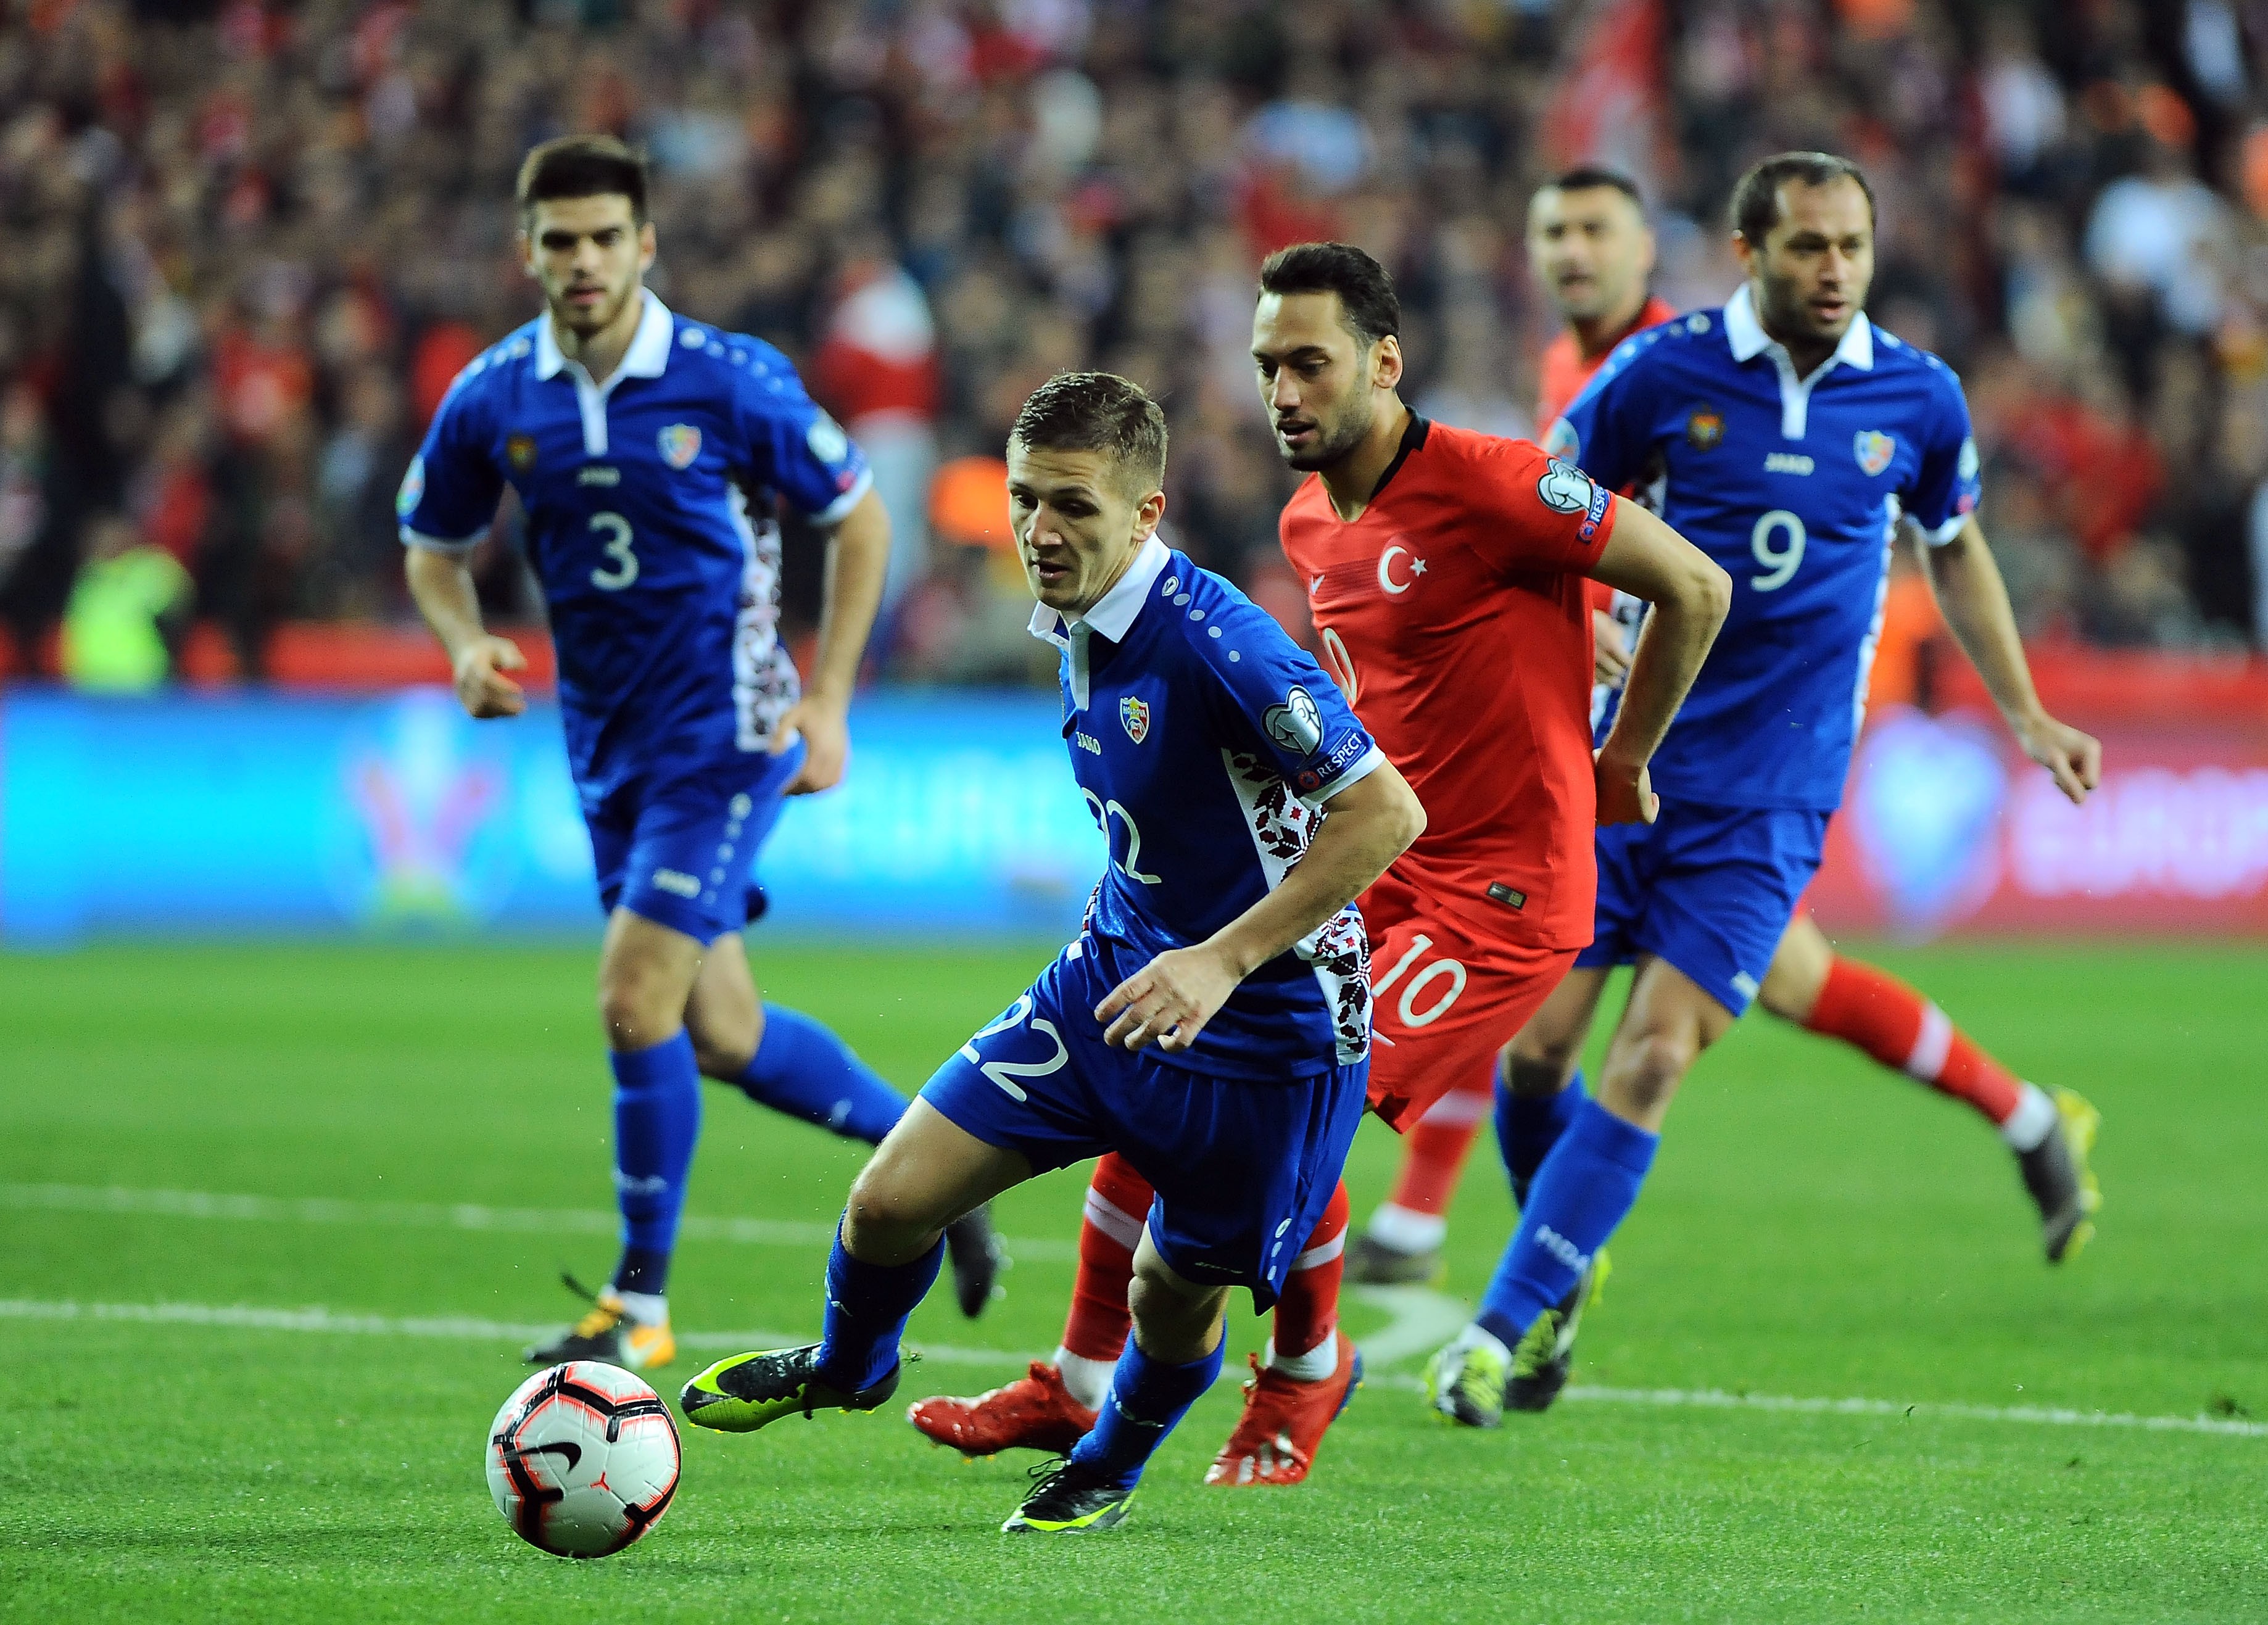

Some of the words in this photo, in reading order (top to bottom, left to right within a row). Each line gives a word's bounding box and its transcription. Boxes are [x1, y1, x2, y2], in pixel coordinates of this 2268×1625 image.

[588, 511, 639, 590] 3
[1751, 510, 1807, 592] 9
[1076, 731, 1101, 756] JAKO
[1317, 732, 1362, 778] RESPECT
[1370, 933, 1467, 1028] 10
[958, 993, 1069, 1102] 22
